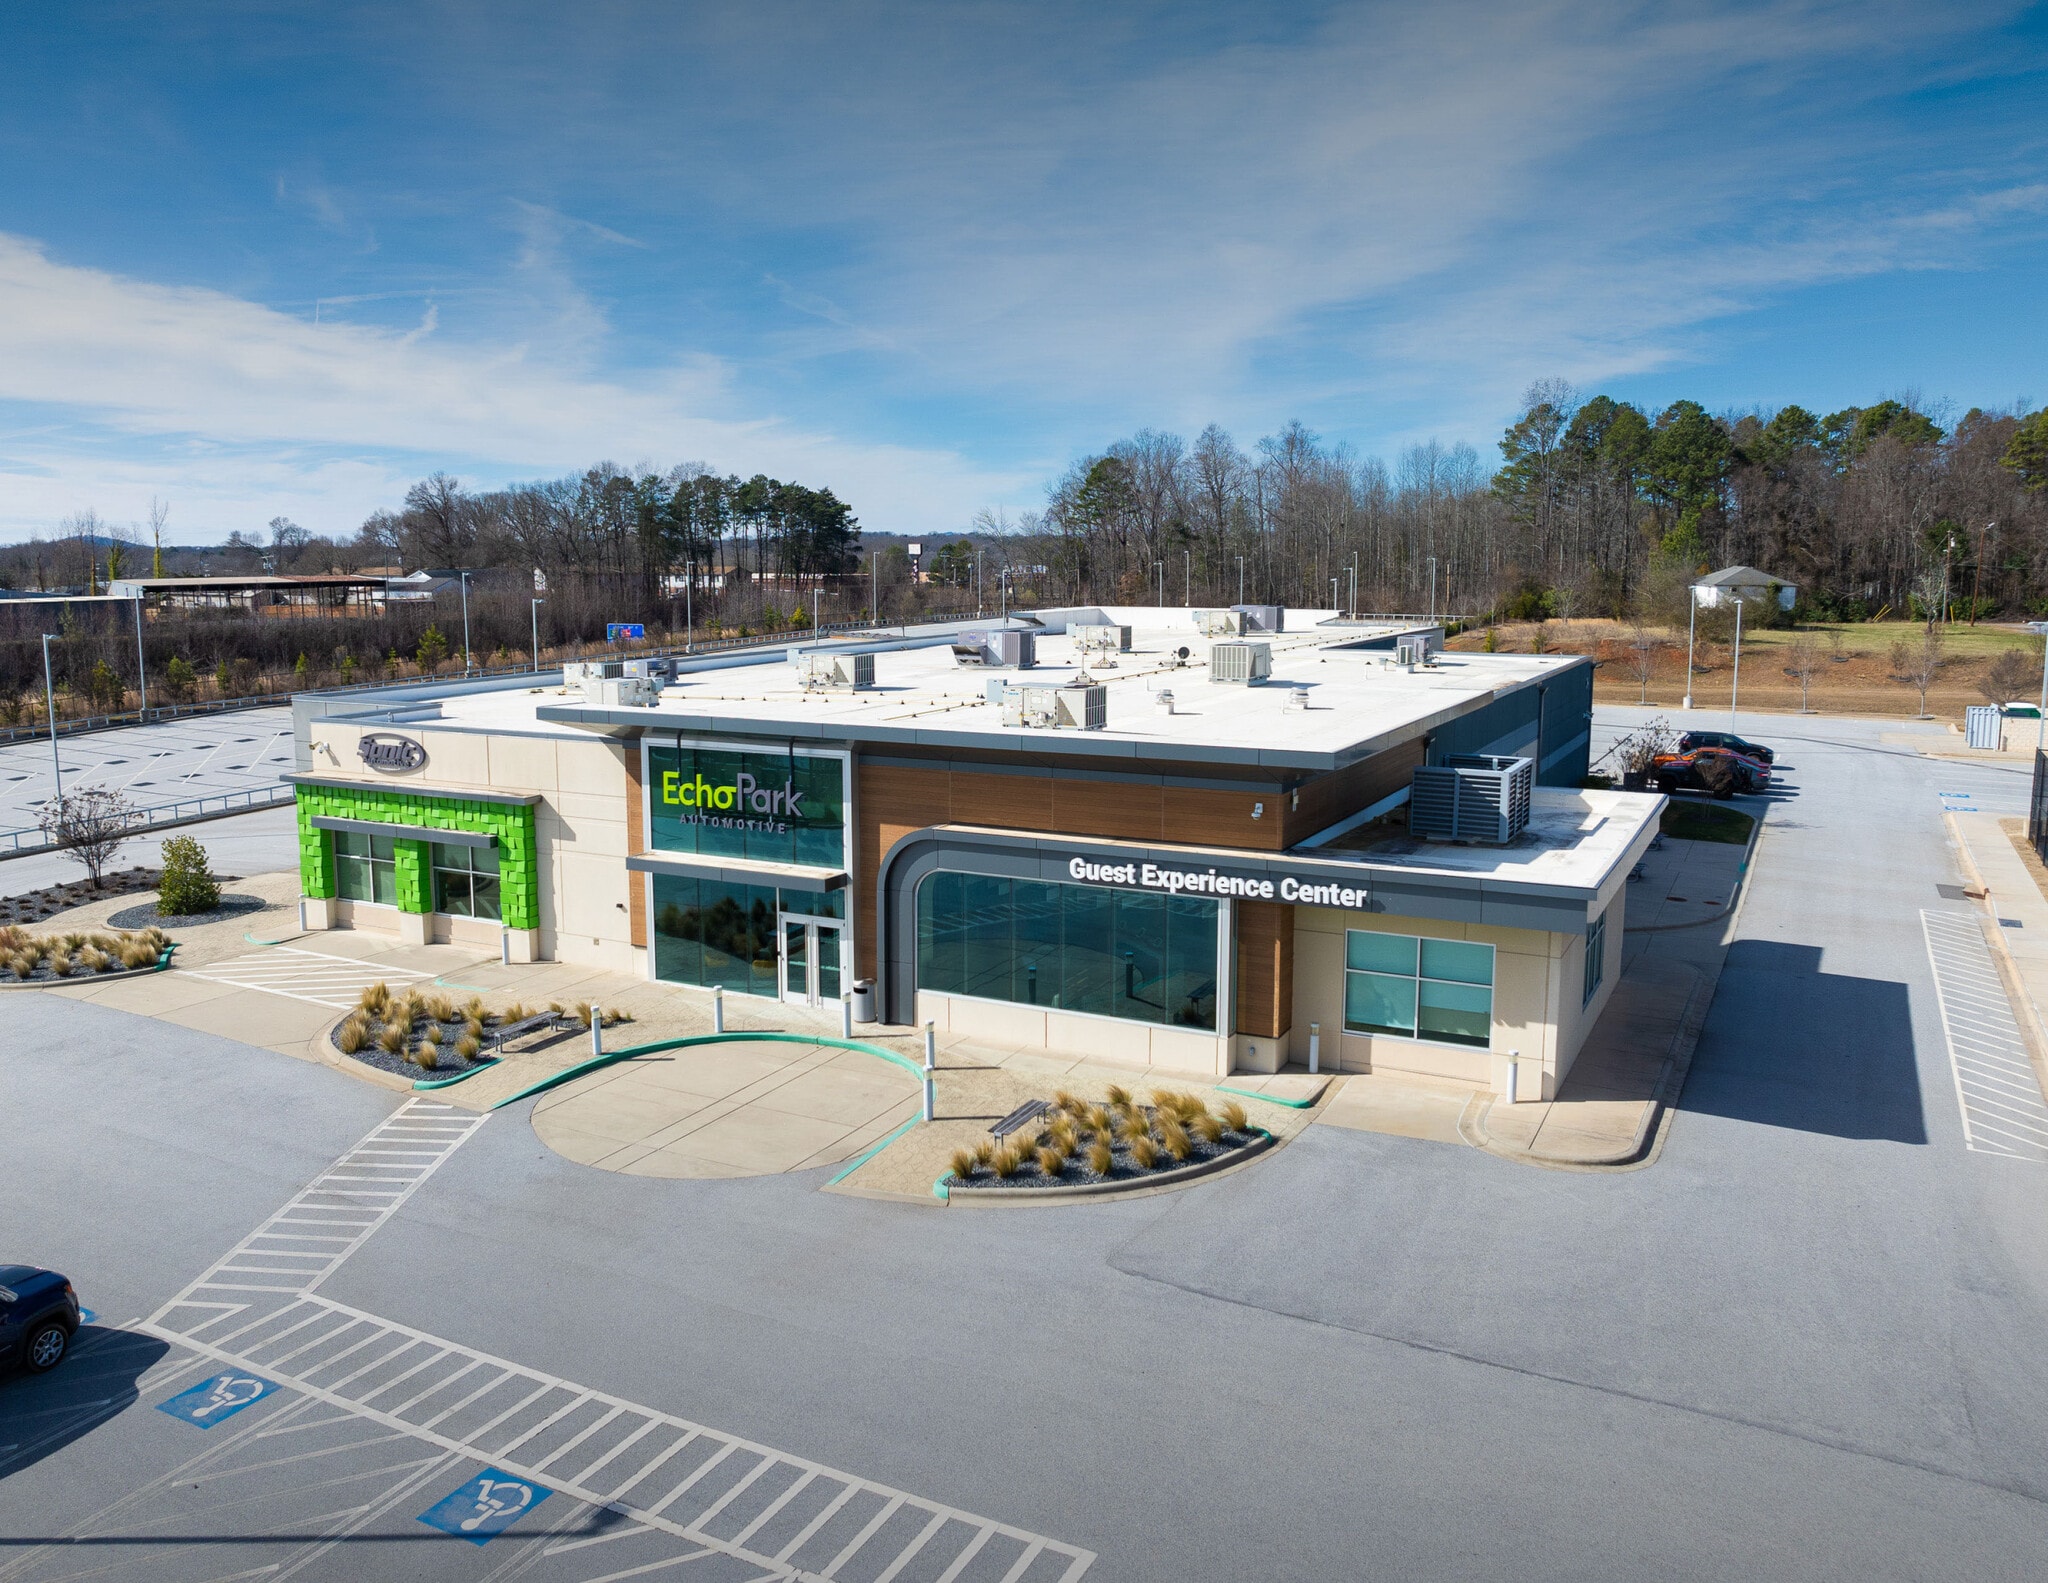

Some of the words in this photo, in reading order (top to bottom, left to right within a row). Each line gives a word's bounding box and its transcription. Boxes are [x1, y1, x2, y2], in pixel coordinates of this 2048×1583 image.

[358, 739, 416, 760] Sonic
[663, 770, 803, 817] EchoPark
[680, 814, 786, 834] AUTOMOTIVE
[1069, 857, 1136, 885] Guest
[1141, 863, 1274, 898] Experience
[1281, 877, 1367, 908] Center
